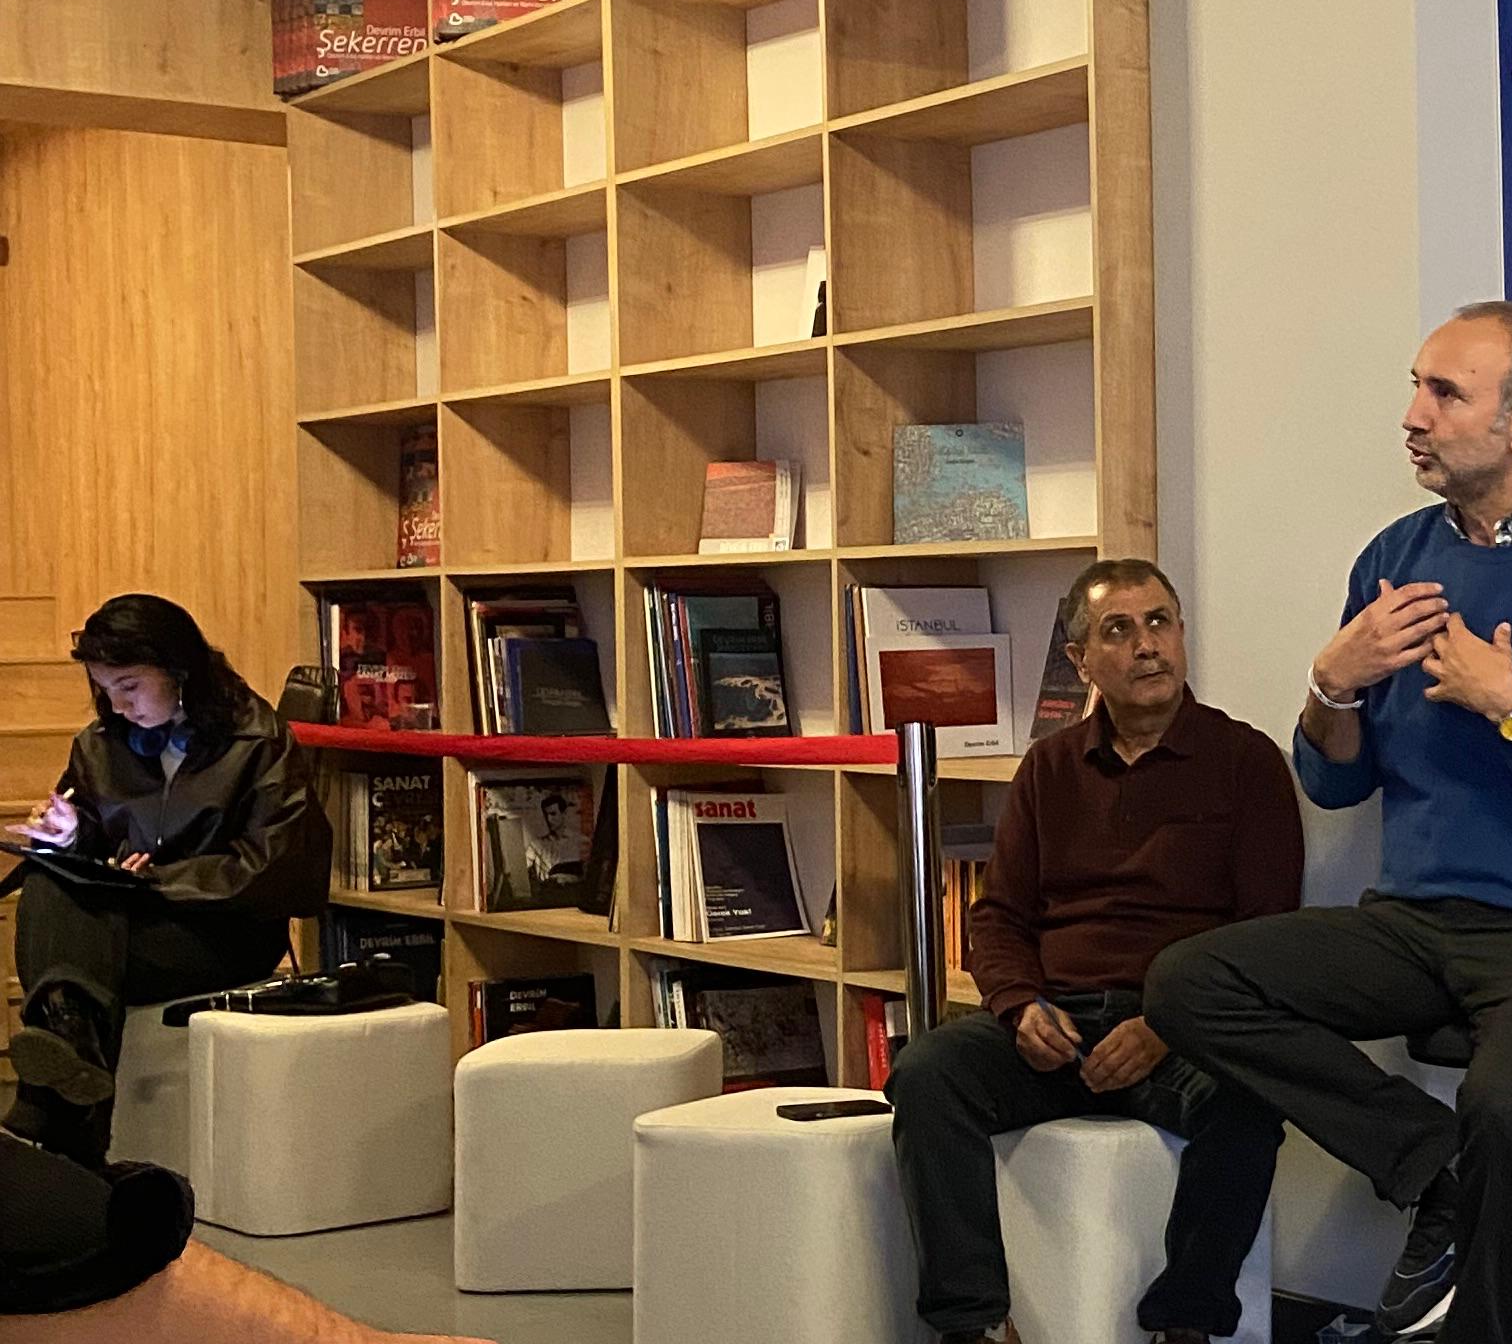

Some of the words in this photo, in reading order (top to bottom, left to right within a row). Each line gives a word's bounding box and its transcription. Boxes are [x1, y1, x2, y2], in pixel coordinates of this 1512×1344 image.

[366, 24, 402, 37] Devrim
[403, 26, 426, 37] Erbil
[316, 29, 428, 58] Şekerren
[372, 774, 432, 792] SANAT
[694, 798, 757, 819] sanat
